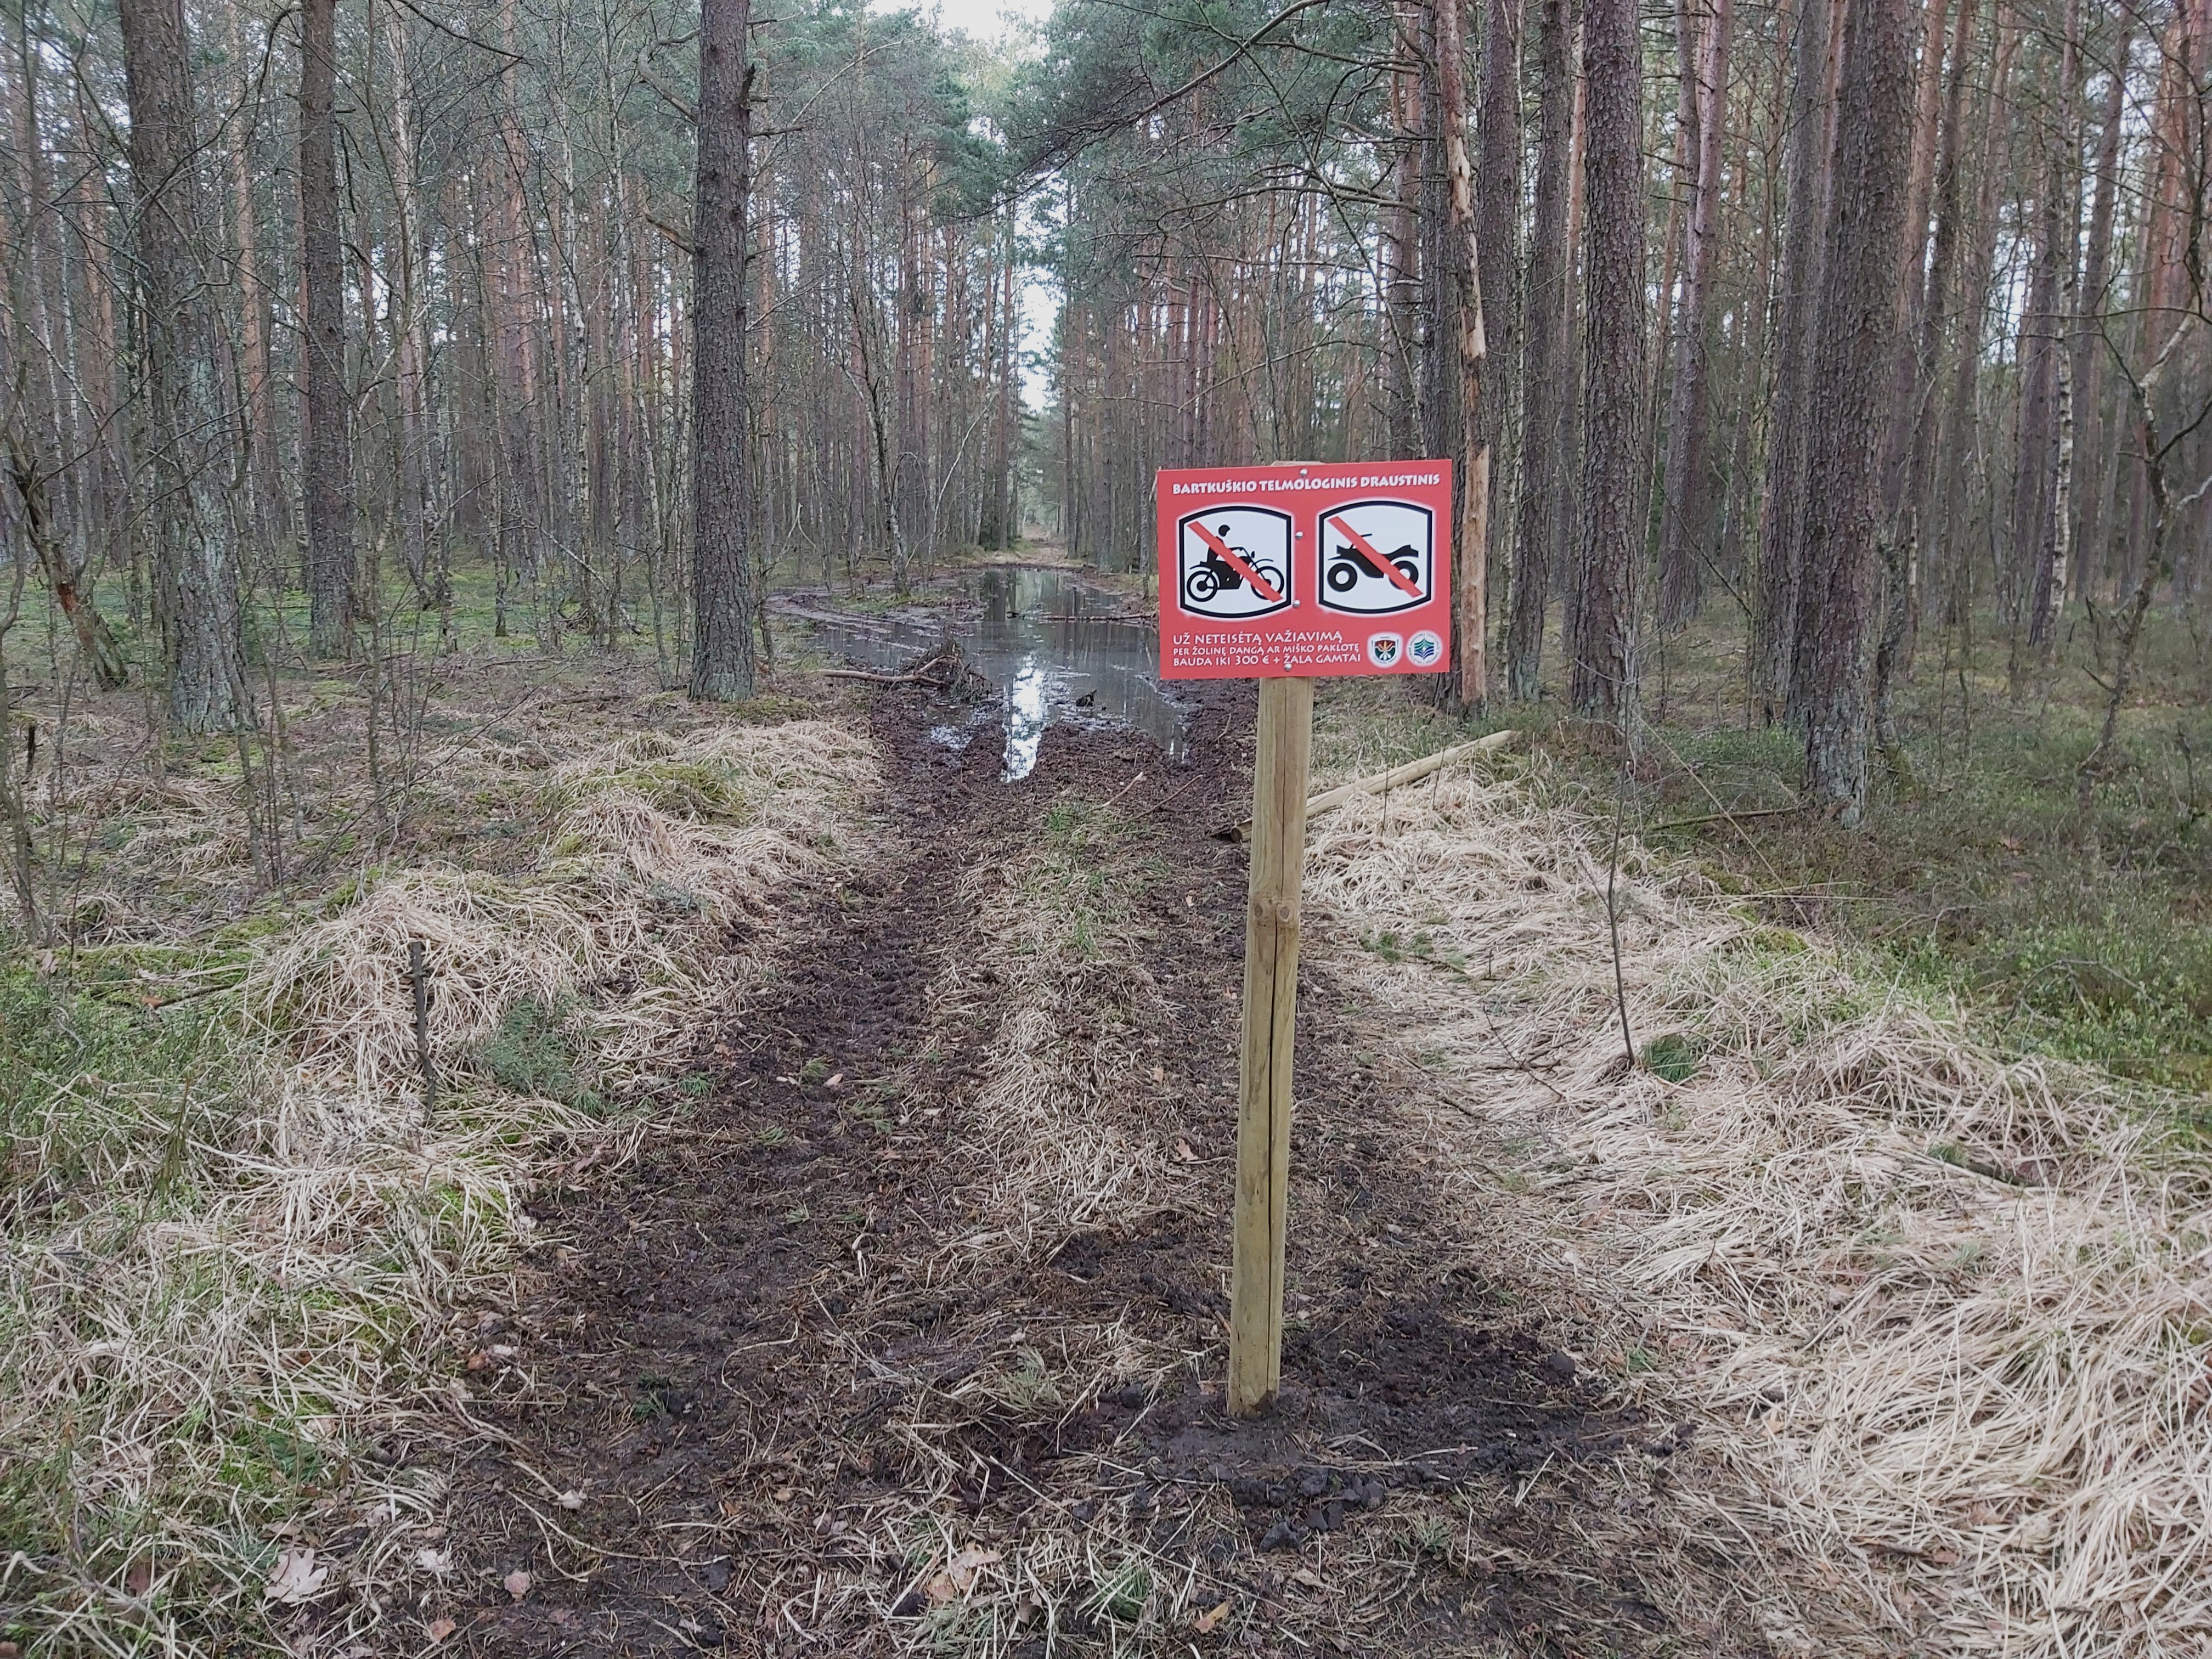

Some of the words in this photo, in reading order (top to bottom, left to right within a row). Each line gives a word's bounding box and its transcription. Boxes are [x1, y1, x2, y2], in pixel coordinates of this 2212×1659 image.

[1173, 479, 1257, 494] BARTKUŠKIO
[1259, 477, 1358, 491] TELMOLOGINIS
[1361, 474, 1440, 487] DRAUSTINIS
[1173, 632, 1190, 645] UŽ
[1194, 631, 1262, 645] NETEISĖTĄ
[1265, 629, 1342, 643] VAŽIAVIMĄ
[1173, 647, 1189, 656] PER
[1192, 645, 1226, 657] ŽOLINĘ
[1229, 646, 1263, 655] DANGĄ
[1283, 644, 1314, 653] MIŠKO
[1317, 643, 1359, 653] PAKLOTĘ
[1173, 657, 1212, 667] BAUDA
[1216, 657, 1231, 665] IKI
[1235, 656, 1259, 665] 300
[1262, 656, 1269, 664] €
[1284, 653, 1313, 664] ŽALA
[1316, 653, 1361, 663] GAMTAI
